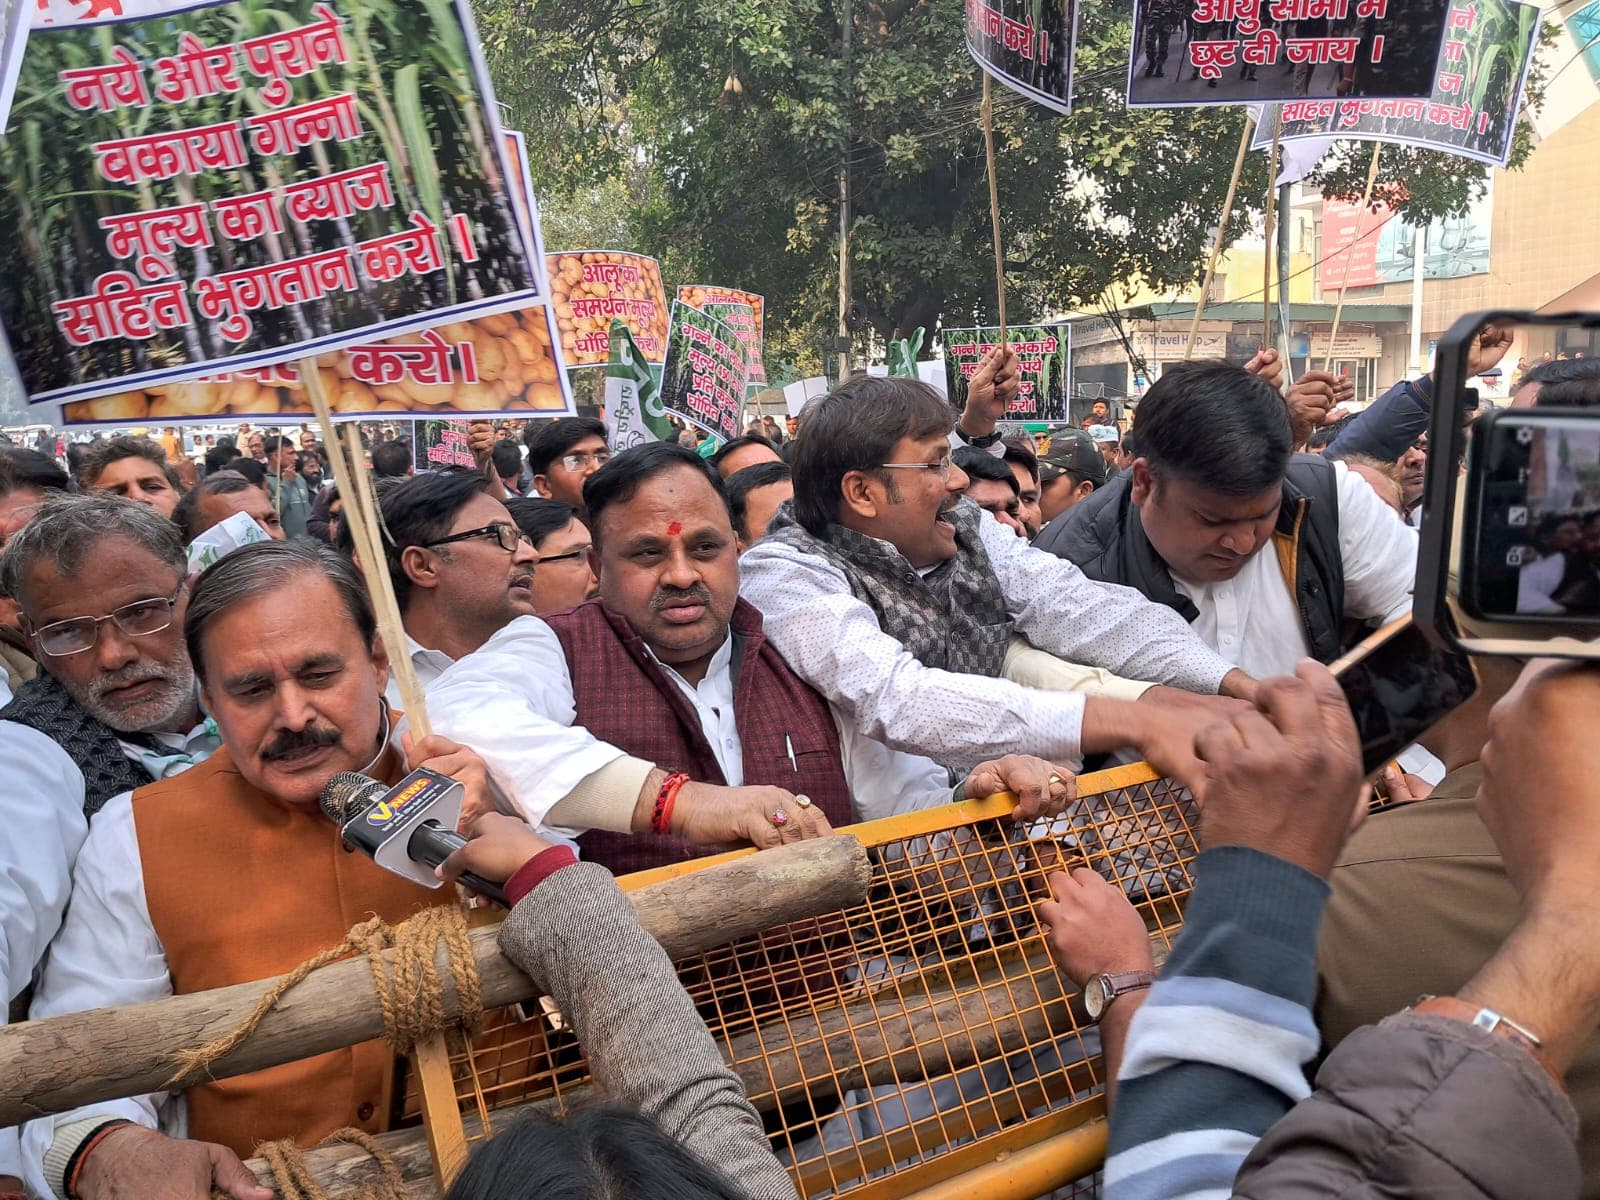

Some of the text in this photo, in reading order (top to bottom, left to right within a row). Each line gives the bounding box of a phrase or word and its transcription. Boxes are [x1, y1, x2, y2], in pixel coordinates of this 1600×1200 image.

[1003, 13, 1035, 60] करो
[1190, 40, 1238, 79] छूट
[1243, 28, 1281, 65] दी
[1286, 37, 1360, 65] जाय
[60, 3, 350, 111] नये और पुराने
[246, 92, 364, 155] गन्ना
[1427, 102, 1473, 131] करो
[99, 203, 214, 281] मूल्य
[213, 191, 284, 241] का
[53, 270, 192, 346] सहित
[196, 246, 357, 342] भुगतान
[358, 209, 446, 283] करो
[583, 263, 639, 292] आलू का
[571, 290, 656, 328] समर्थन मूल्य
[951, 340, 977, 356] गन्ने
[1074, 323, 1095, 336] Travel
[1149, 335, 1180, 345] Travel
[692, 373, 715, 396] प्रति
